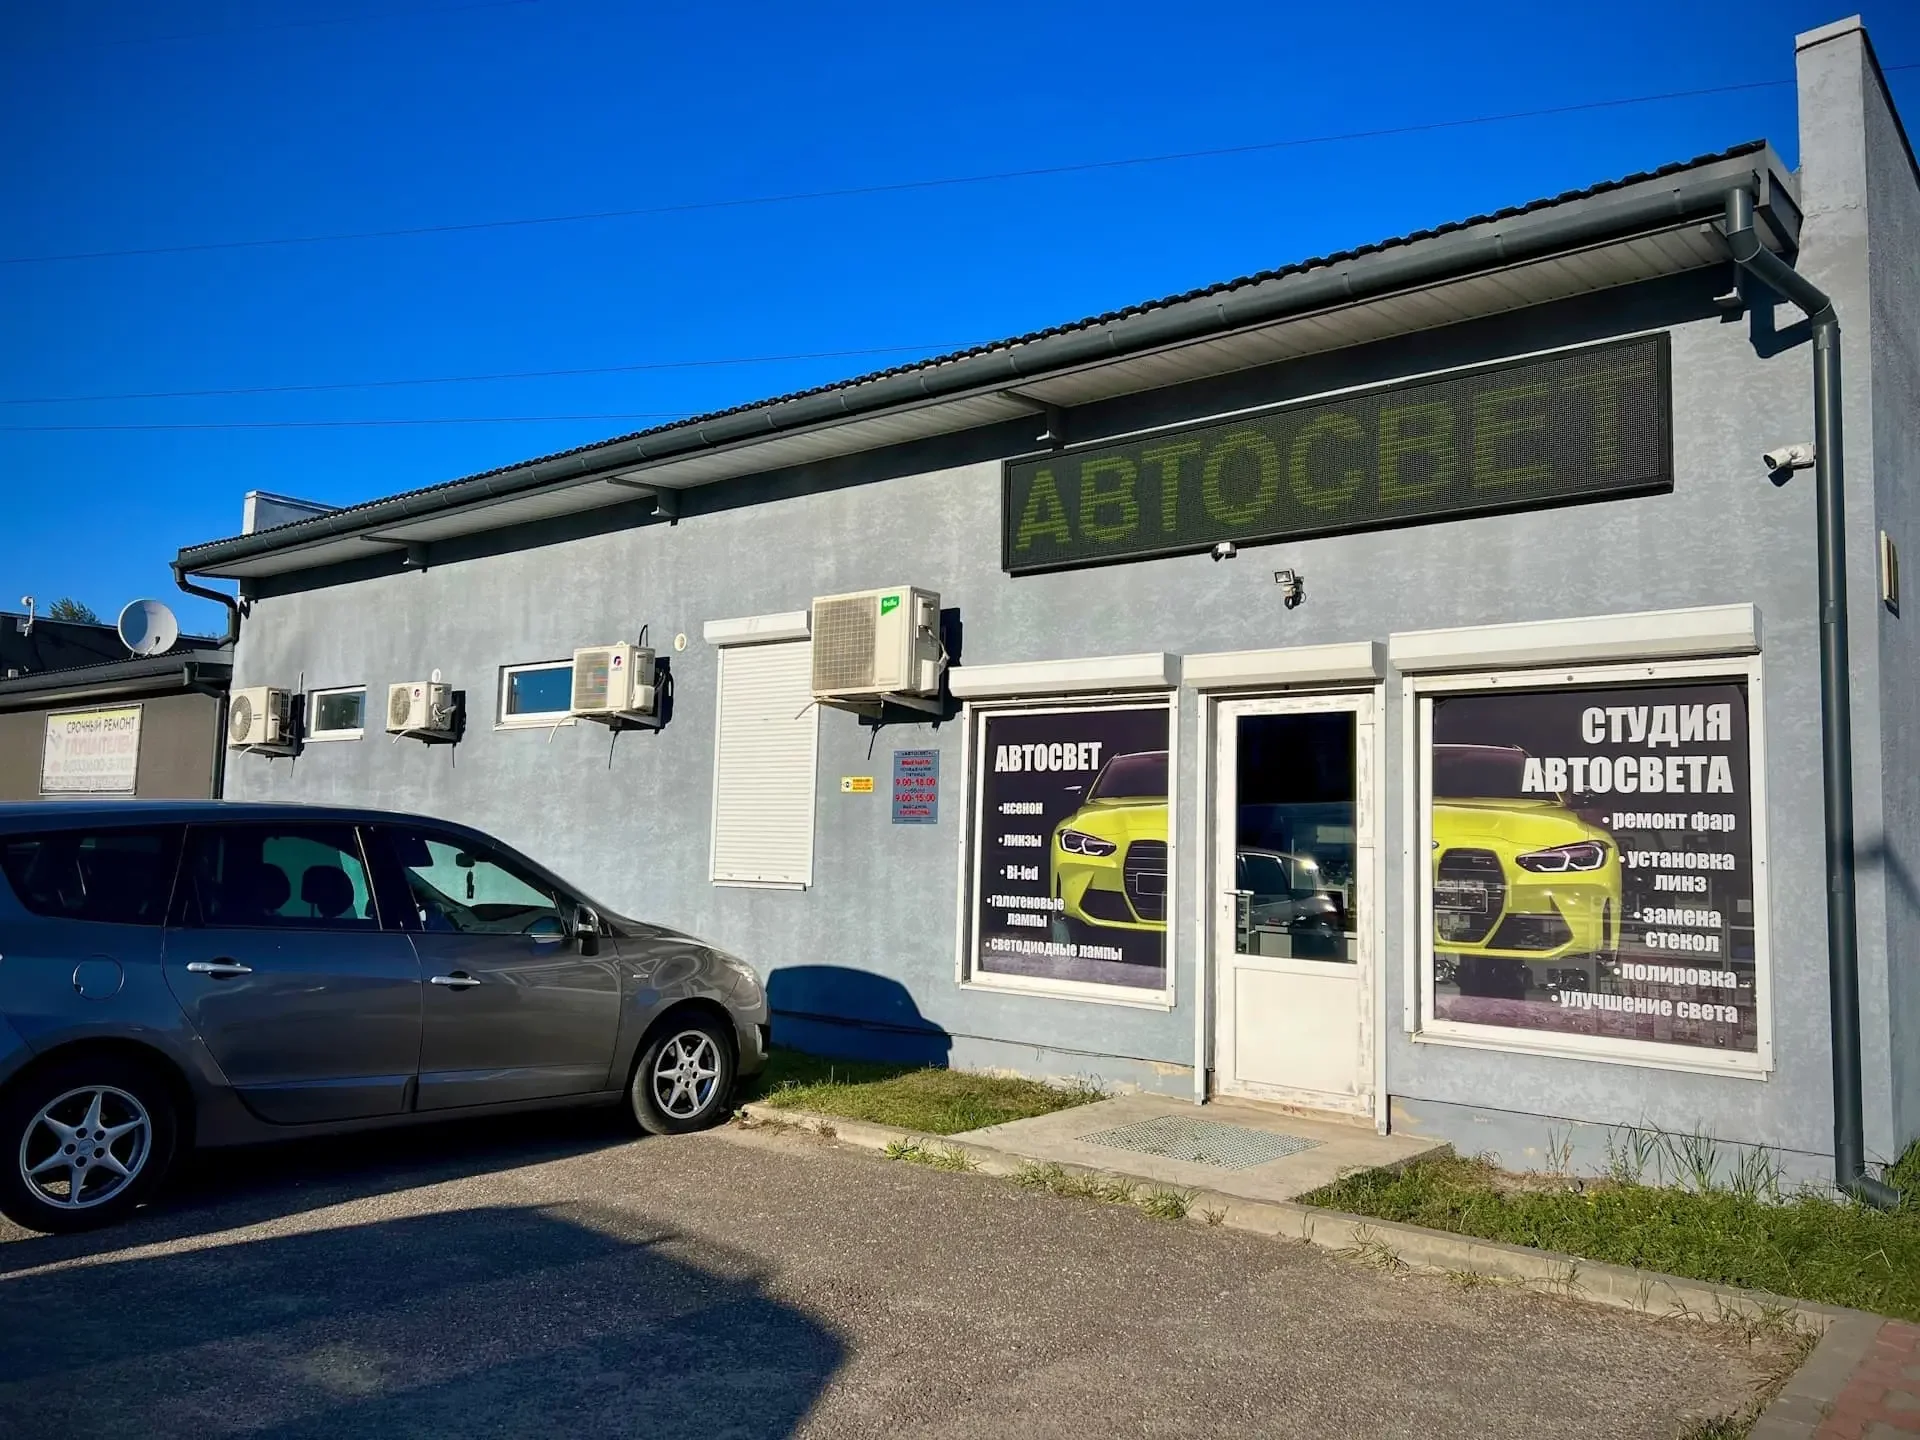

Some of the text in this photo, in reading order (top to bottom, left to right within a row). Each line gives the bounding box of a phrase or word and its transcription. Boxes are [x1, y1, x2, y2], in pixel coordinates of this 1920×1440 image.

[1015, 358, 1649, 552] АВТОСВЕТ
[103, 716, 135, 732] РЕМОНТ
[1581, 703, 1731, 748] СТУДИЯ
[995, 742, 1102, 772] АВТОСВЕТ
[1521, 755, 1734, 793] АВТОСВЕТА
[1003, 802, 1043, 815] ксенон
[1612, 811, 1736, 832] ремонт фар
[1003, 834, 1042, 848] линзы
[1627, 850, 1736, 871] установка
[1006, 865, 1039, 881] Bi-led
[1654, 874, 1707, 892] линз
[991, 894, 1065, 912] галогеновые
[1007, 911, 1047, 927] лампы
[1642, 907, 1722, 928] замена
[991, 938, 1122, 961] светодиодные лампы
[1645, 931, 1720, 952] стекол
[1622, 963, 1737, 989] полировка
[1559, 990, 1739, 1024] улучшение света
